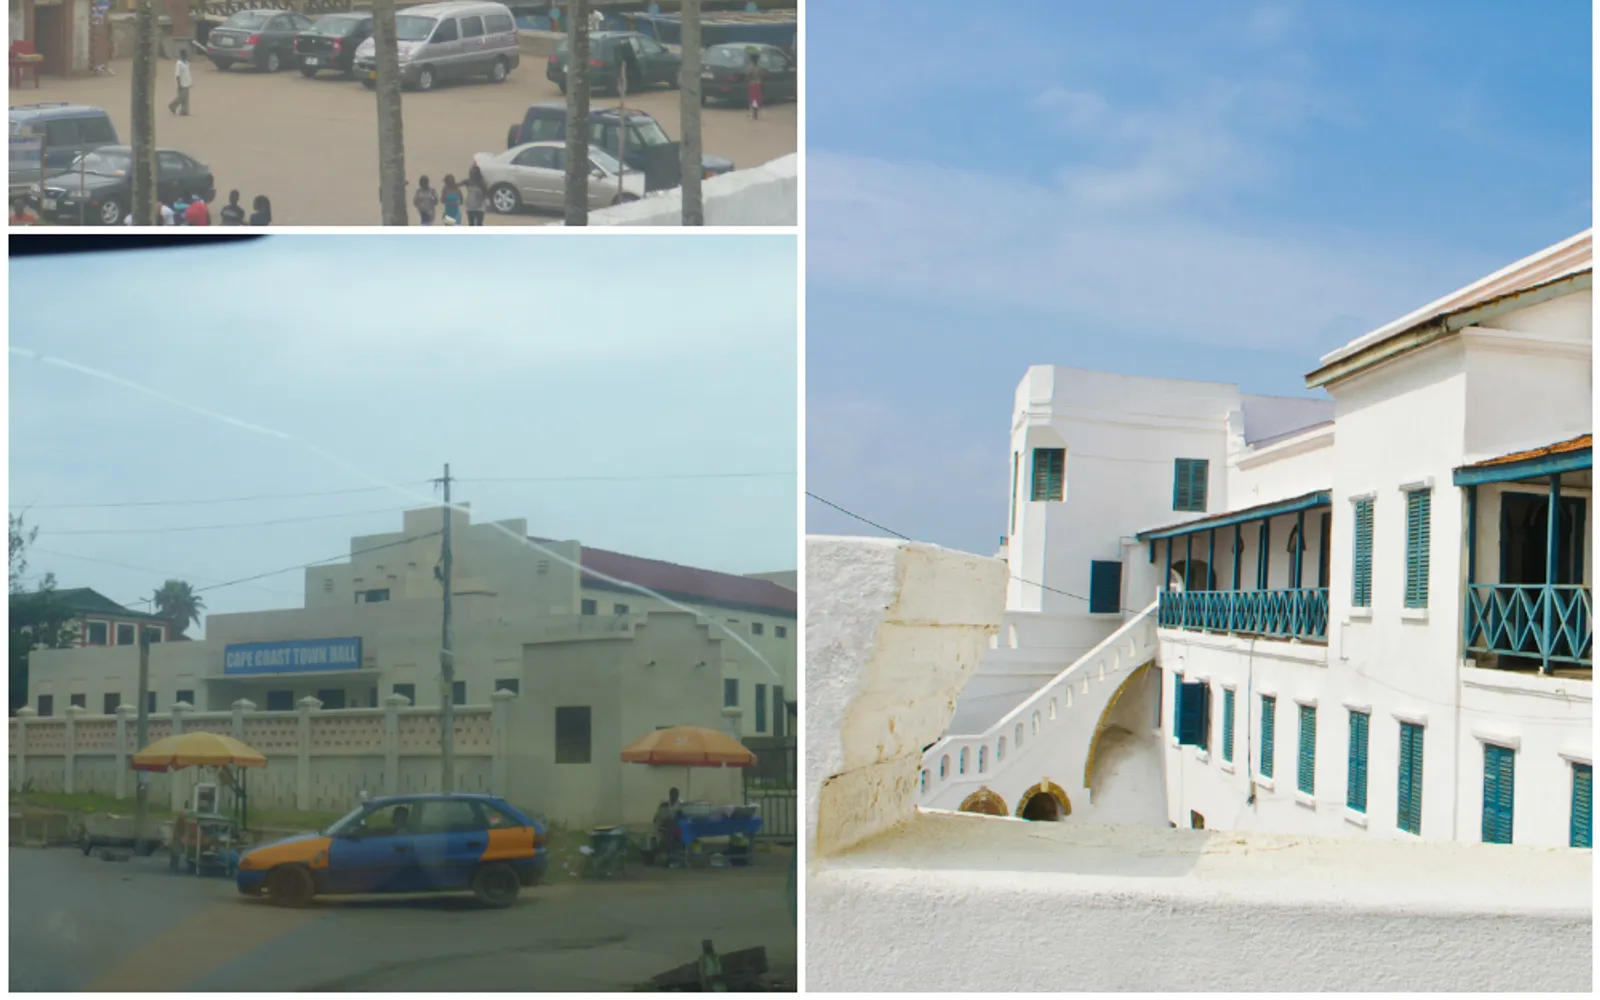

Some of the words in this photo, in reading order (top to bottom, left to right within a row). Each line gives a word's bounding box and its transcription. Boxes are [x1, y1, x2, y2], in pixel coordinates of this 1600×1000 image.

[226, 651, 253, 668] CAPE
[255, 649, 290, 666] COAST
[293, 647, 327, 665] TOWN
[329, 645, 357, 663] HALL
